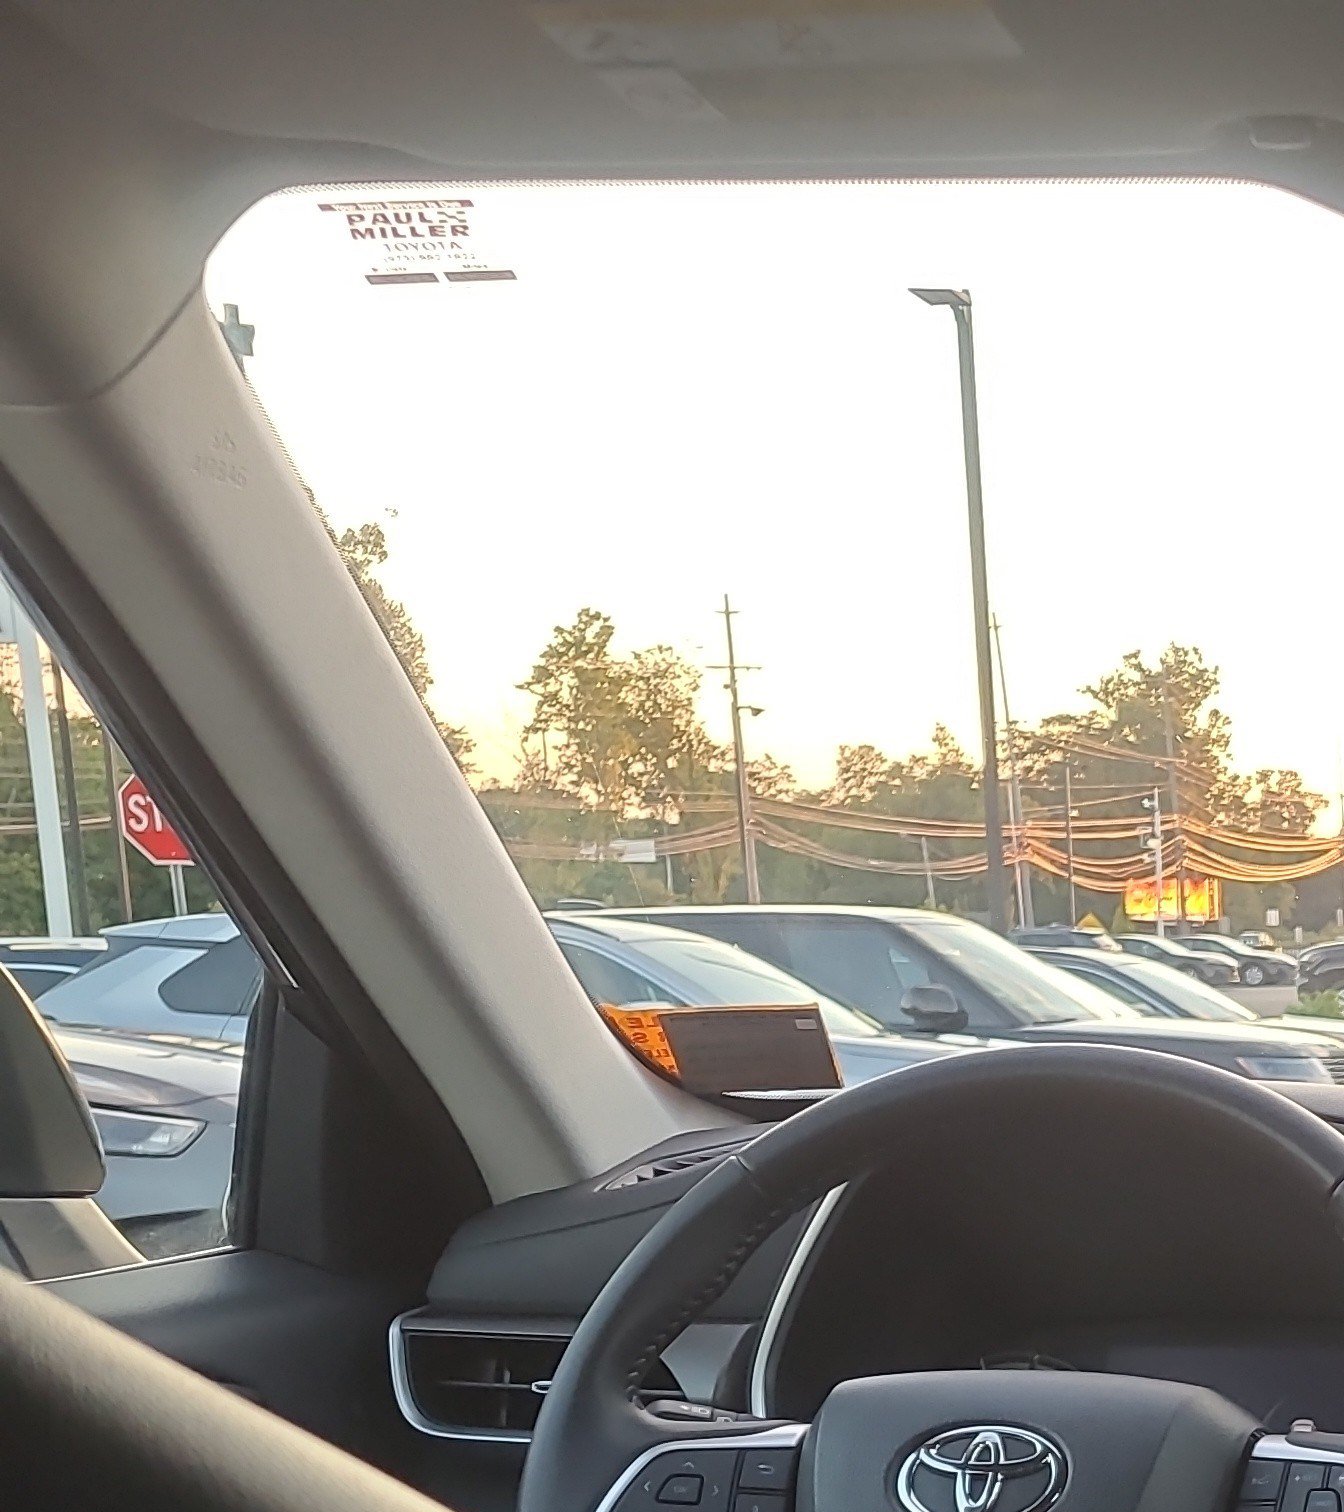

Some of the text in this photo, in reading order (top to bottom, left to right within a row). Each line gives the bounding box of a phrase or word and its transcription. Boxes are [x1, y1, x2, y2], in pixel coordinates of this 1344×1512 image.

[346, 211, 433, 226] PAUL
[350, 225, 469, 240] MILLER
[384, 241, 462, 252] TOYOTA
[128, 793, 163, 832] ST
